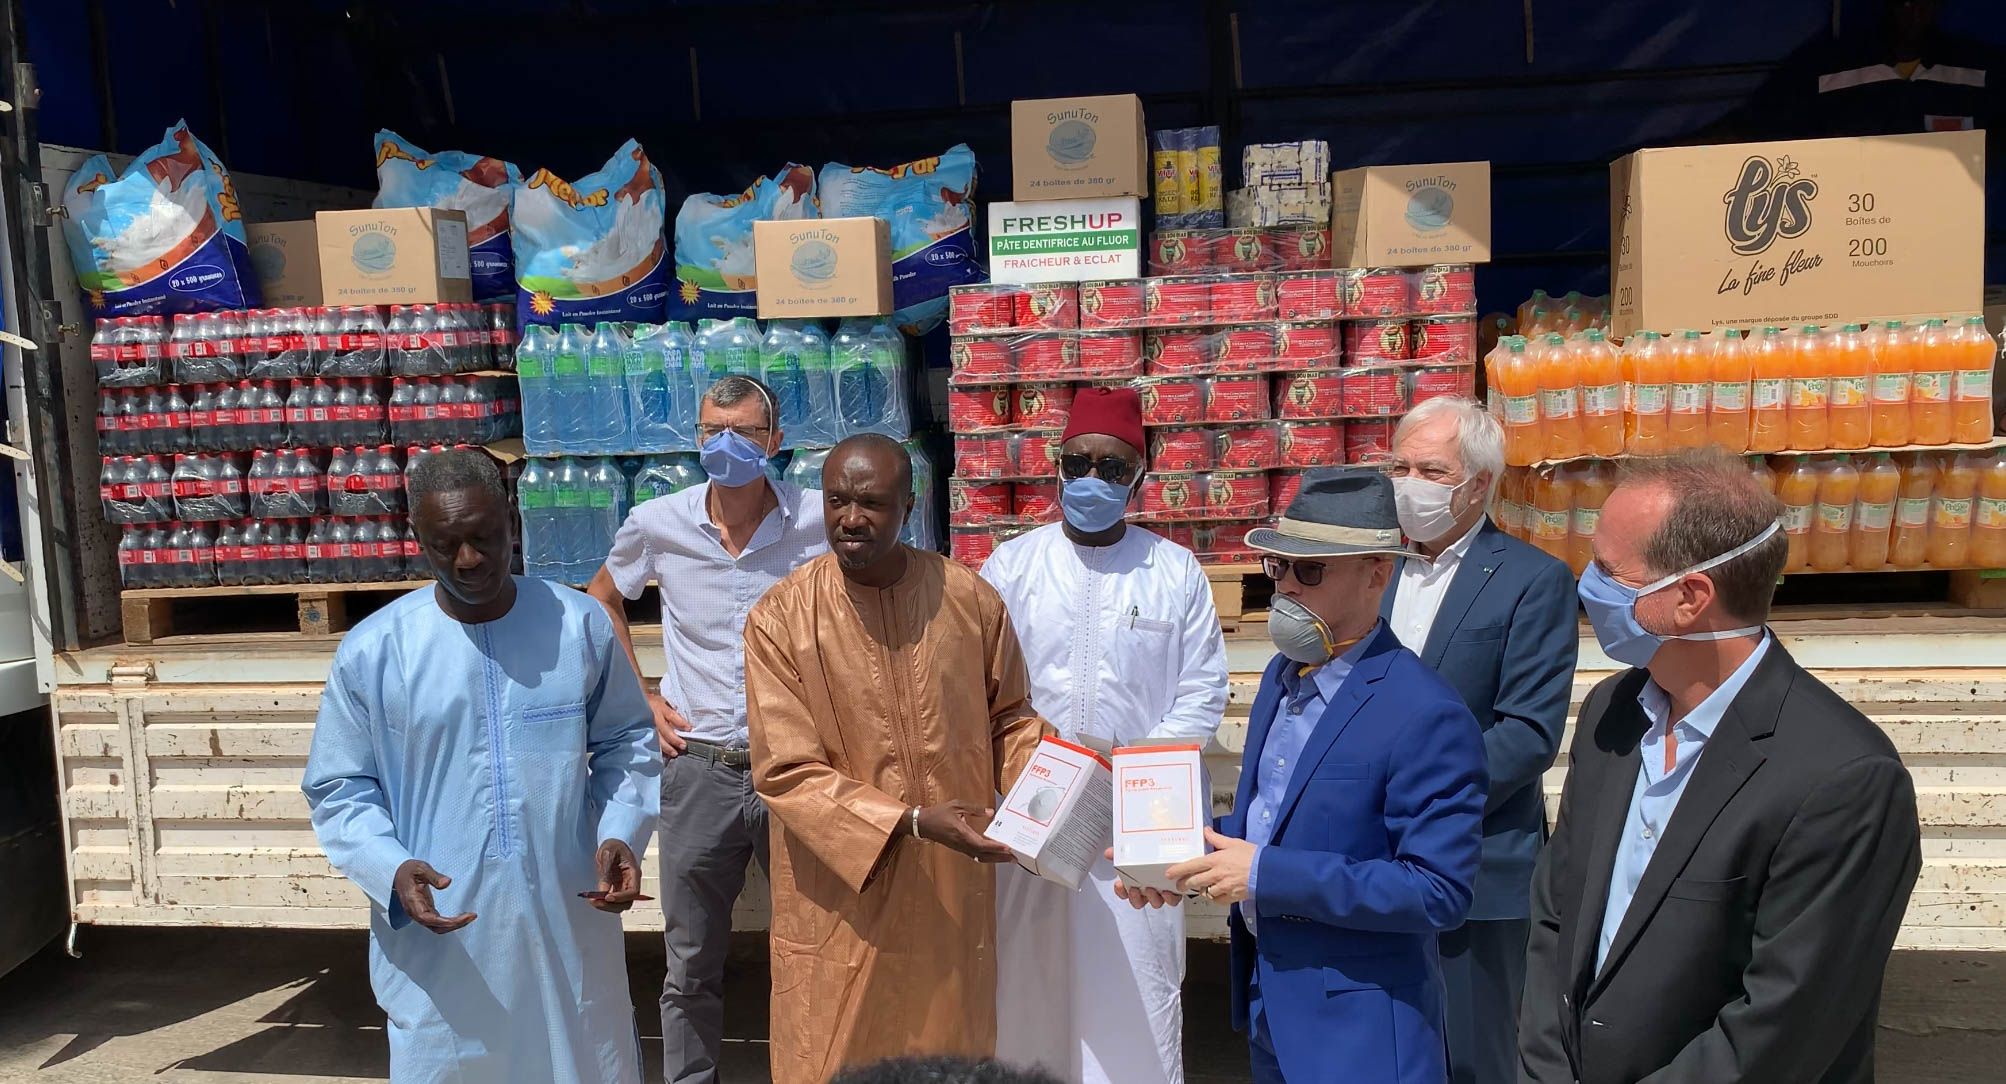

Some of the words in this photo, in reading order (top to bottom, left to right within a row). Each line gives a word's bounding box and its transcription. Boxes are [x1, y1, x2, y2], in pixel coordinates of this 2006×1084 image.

[1046, 107, 1099, 125] SunuTon
[1105, 177, 1116, 185] gr
[1405, 175, 1457, 193] SunuTon
[1848, 193, 1875, 213] 30
[1002, 212, 1123, 233] FRESHUP
[1845, 216, 1876, 226] Boîtes
[1879, 215, 1892, 224] de
[349, 220, 398, 237] SunuTon
[789, 228, 840, 245] SunuTon
[996, 238, 1021, 251] PÂTE
[1022, 237, 1080, 249] DENTIFRICE
[1081, 236, 1095, 246] AU
[1096, 235, 1129, 246] FLUOR
[1462, 244, 1473, 253] gr
[1848, 237, 1887, 257] 200
[930, 252, 939, 261] 20
[1003, 256, 1070, 269] FRAICHEUR
[1072, 255, 1082, 265] &
[1084, 254, 1122, 265] ECLAT
[1852, 258, 1894, 268] Mouchoirs
[1718, 268, 1740, 294] La
[1744, 259, 1776, 295] fine
[1780, 248, 1823, 286] fleur
[172, 279, 180, 288] 20
[378, 286, 390, 294] de
[408, 285, 417, 294] gr
[1620, 287, 1633, 306] 200
[1738, 317, 1762, 325] marque
[1800, 314, 1823, 322] groupe
[1031, 764, 1051, 778] FFP3
[1124, 778, 1156, 788] FFP3
